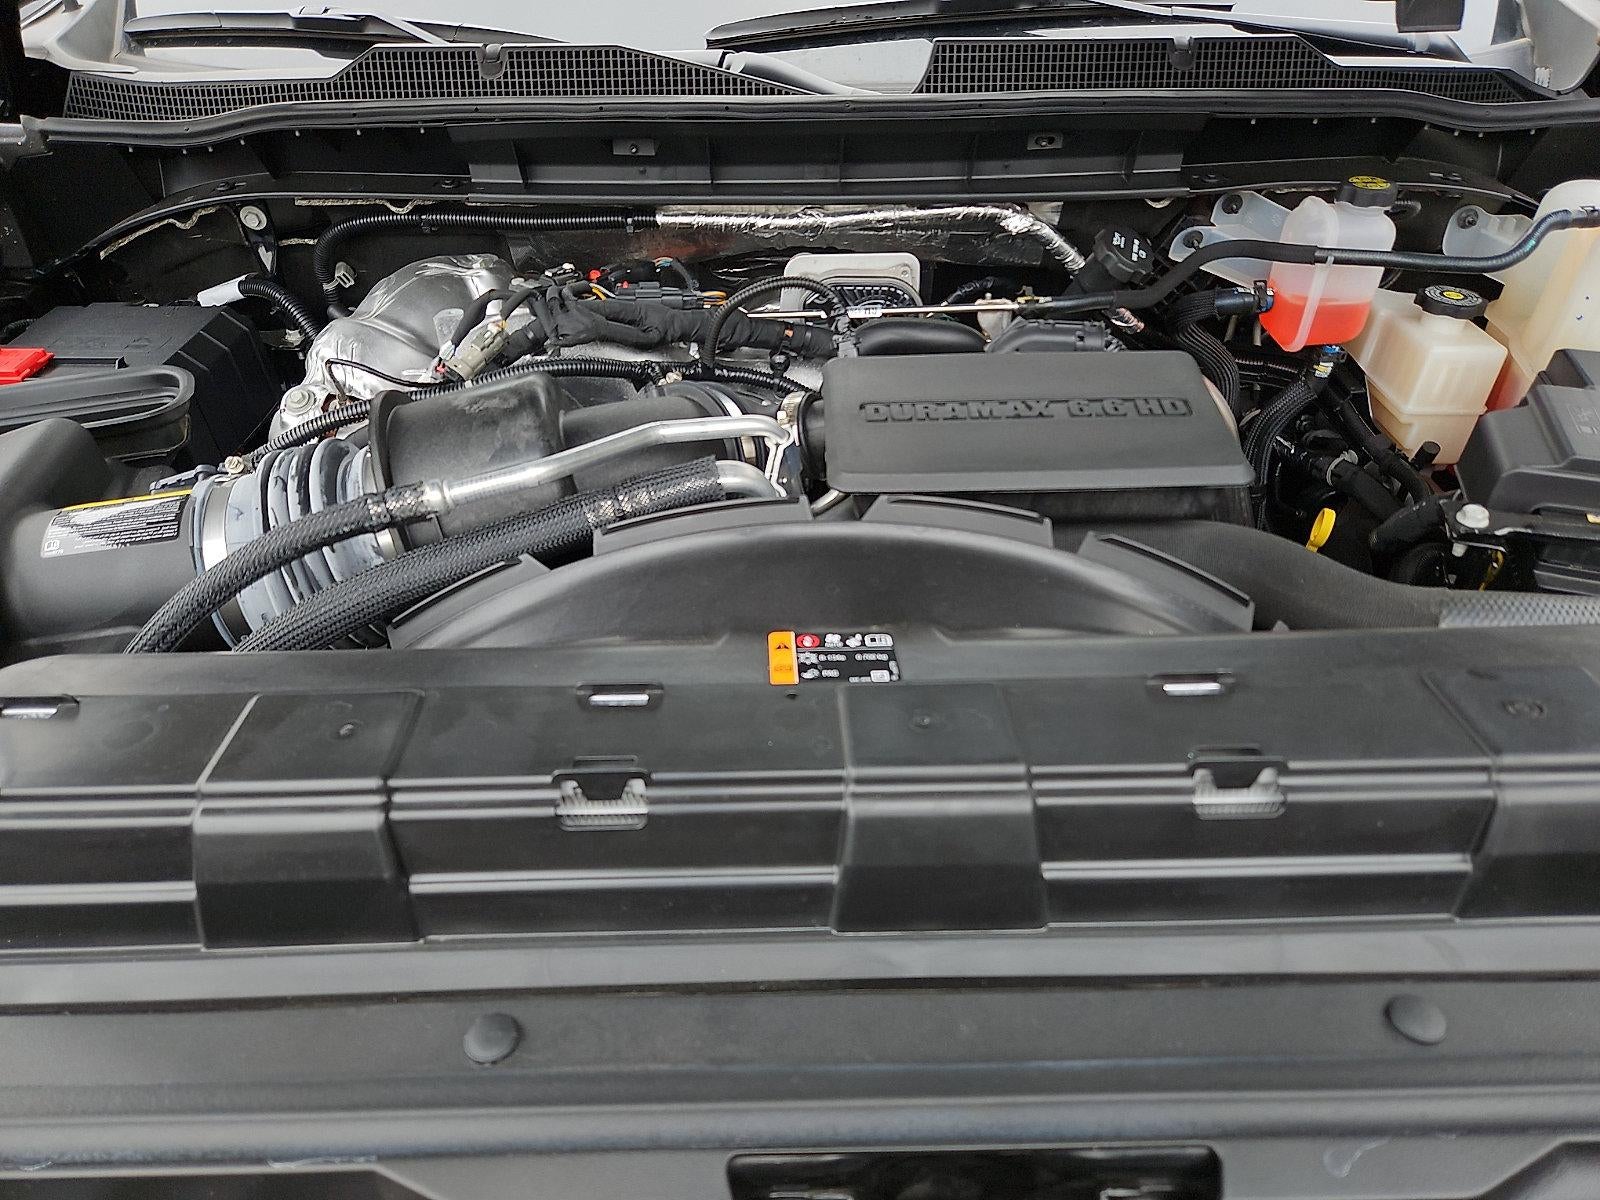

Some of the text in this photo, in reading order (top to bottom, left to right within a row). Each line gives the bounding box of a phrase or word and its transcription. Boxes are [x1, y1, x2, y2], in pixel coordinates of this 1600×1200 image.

[862, 398, 1193, 422] DURAMAX 6.6 HD
